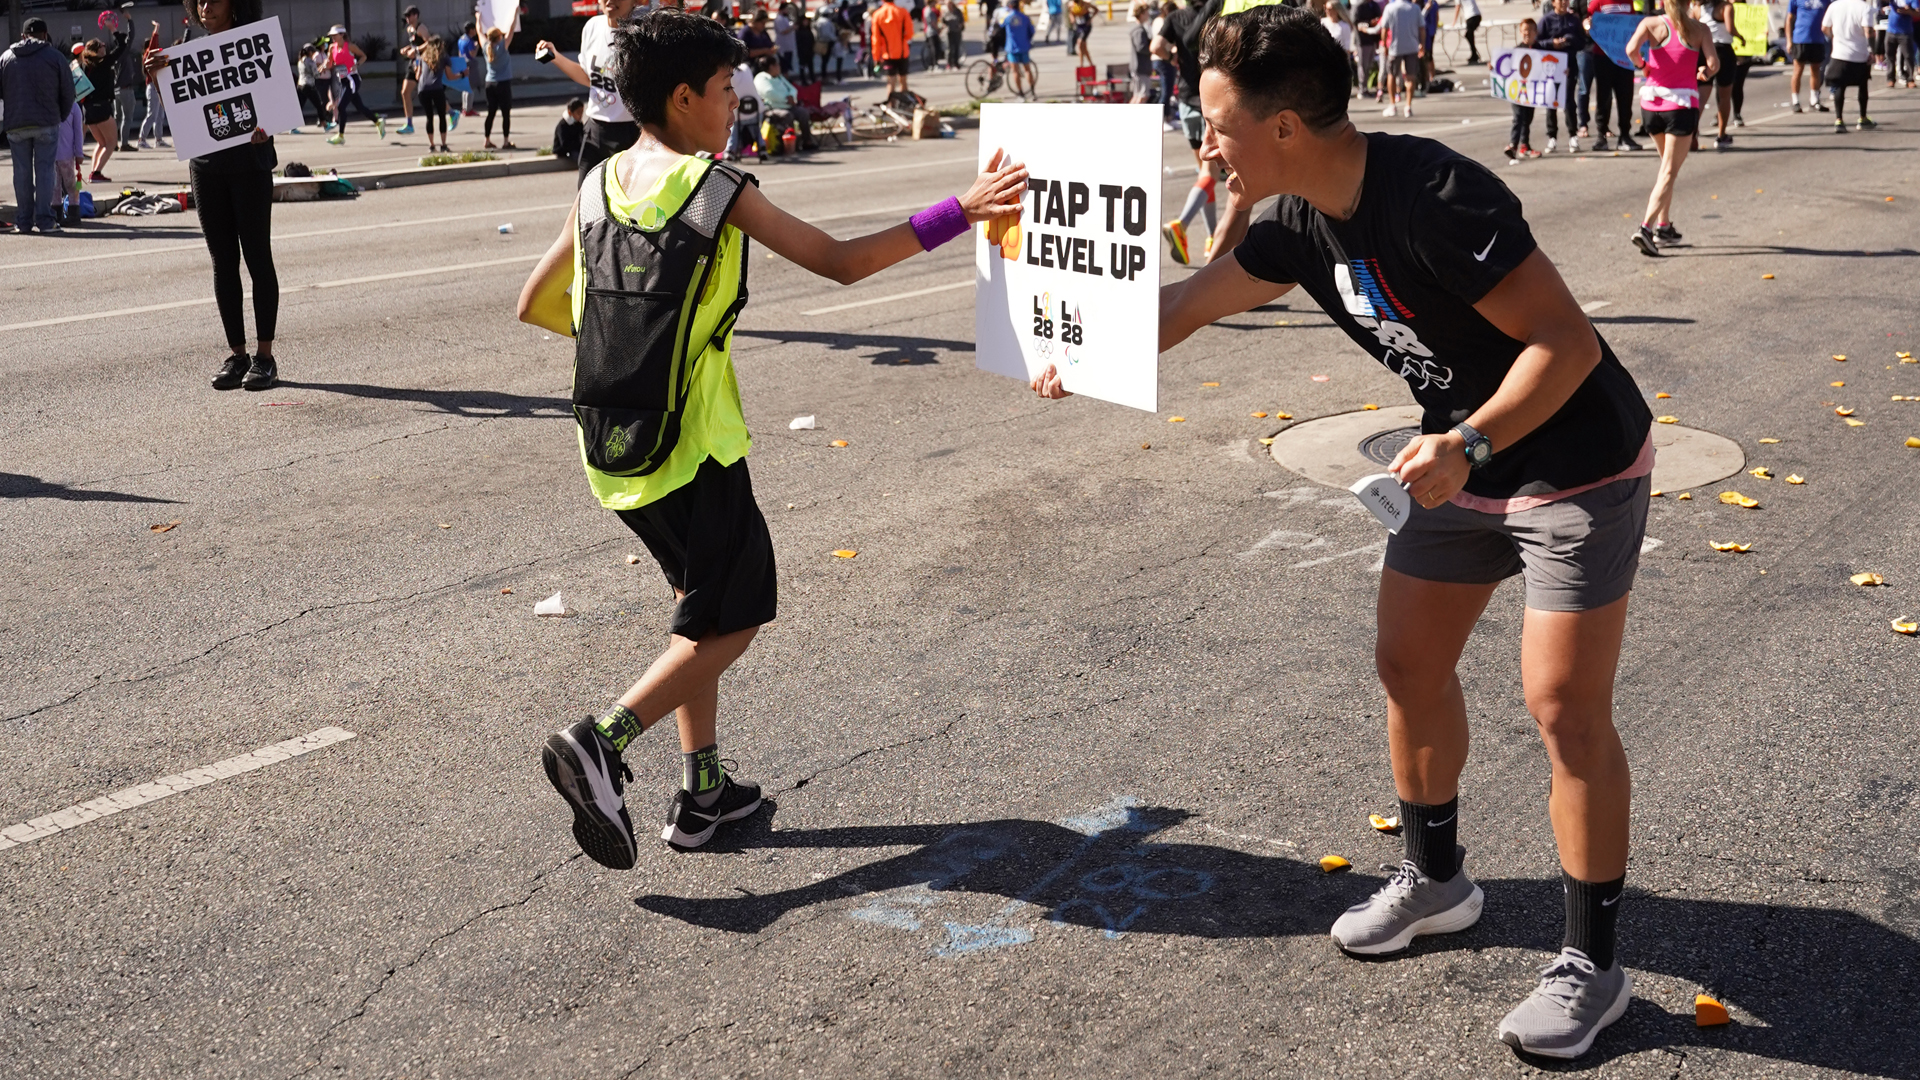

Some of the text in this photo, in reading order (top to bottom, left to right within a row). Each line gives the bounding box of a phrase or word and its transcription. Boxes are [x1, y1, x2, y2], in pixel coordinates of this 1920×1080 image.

[167, 33, 272, 79] TAP FOR
[1495, 53, 1532, 79] GO
[170, 54, 273, 104] ENERGY
[590, 73, 616, 93] 28
[211, 115, 229, 129] 28
[233, 110, 252, 123] 28
[1028, 177, 1147, 236] TAP TO
[1027, 231, 1146, 281] LEVEL UP
[1033, 316, 1054, 339] 28
[1061, 322, 1083, 346] 28
[1378, 495, 1401, 520] fitbit
